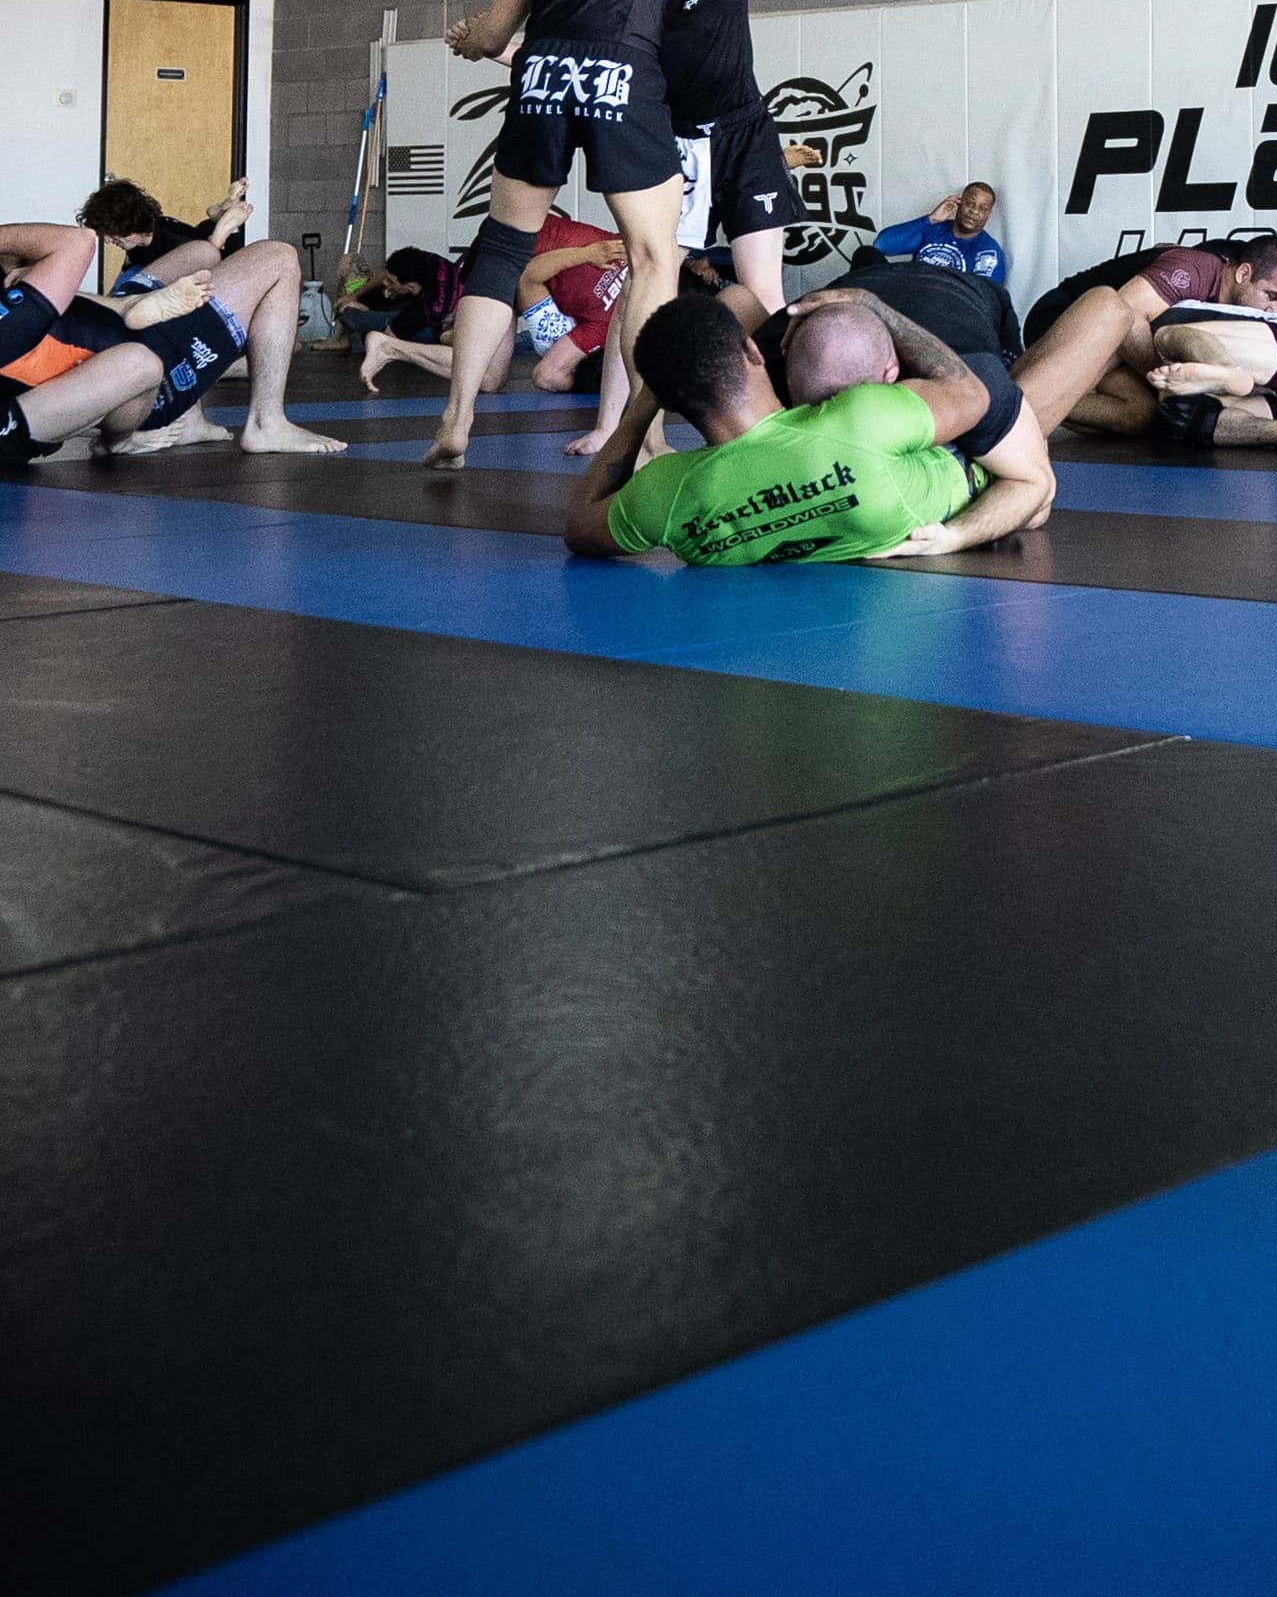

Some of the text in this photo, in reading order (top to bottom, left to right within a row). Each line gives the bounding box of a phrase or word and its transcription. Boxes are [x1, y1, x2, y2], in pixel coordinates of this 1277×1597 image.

[520, 55, 633, 107] LXB
[520, 104, 625, 122] LEVEL BLACK
[707, 497, 852, 553] WORLDWIDE
